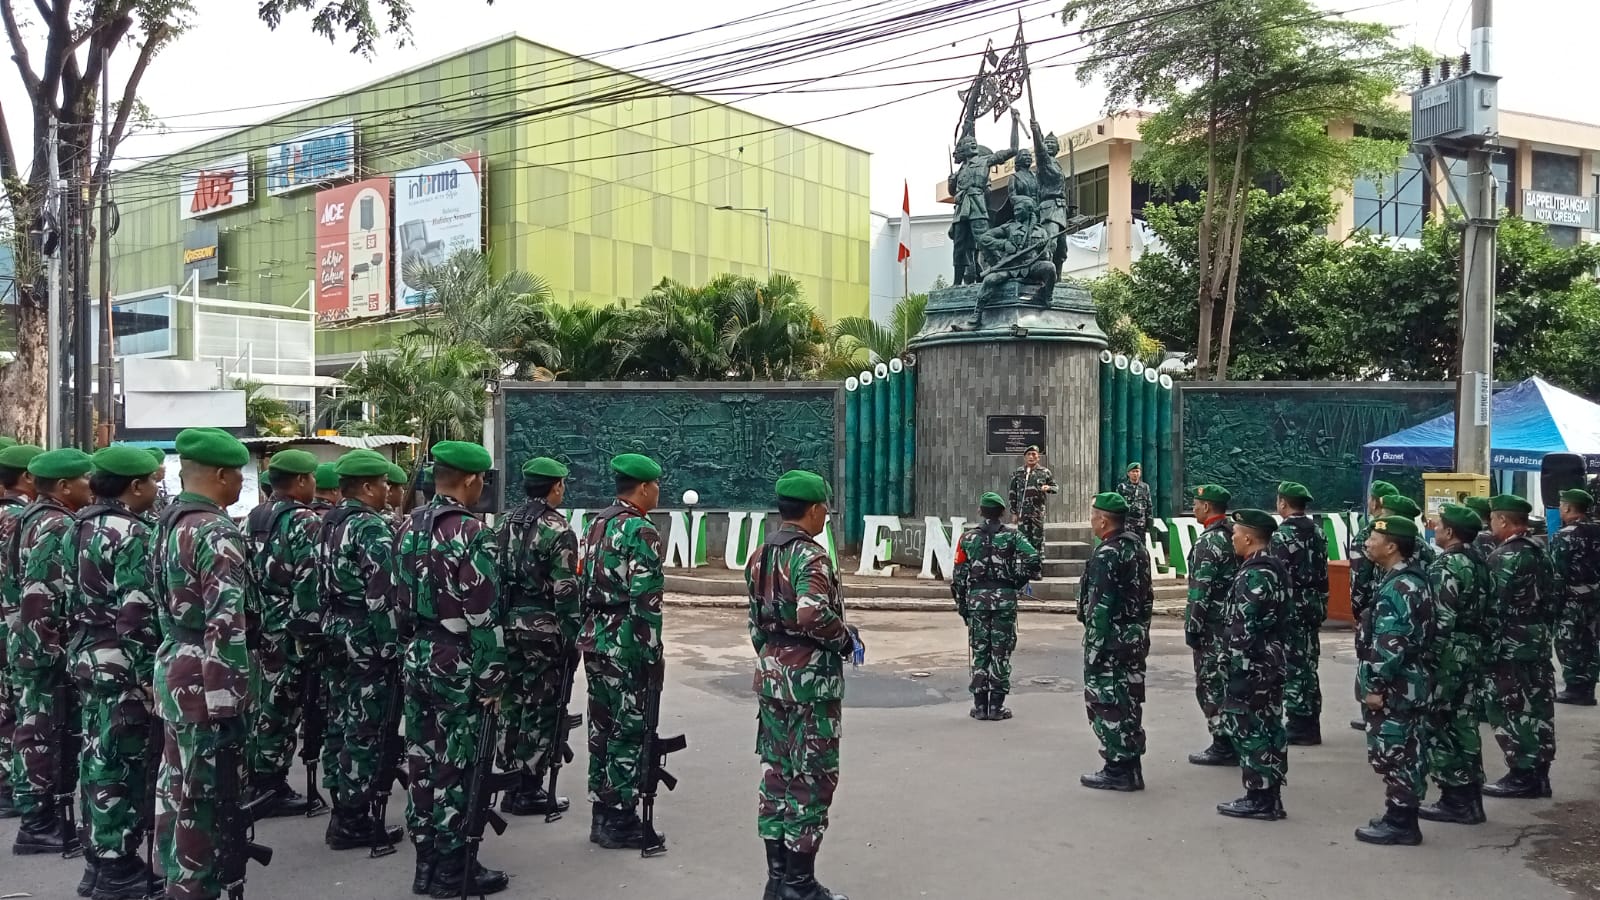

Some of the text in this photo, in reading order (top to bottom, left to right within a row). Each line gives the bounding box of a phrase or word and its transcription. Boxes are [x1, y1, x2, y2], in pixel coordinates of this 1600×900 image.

[190, 169, 234, 213] ACE
[408, 168, 458, 200] informa
[320, 202, 345, 224] ACE
[1535, 209, 1581, 224] KOTA CIREBON
[321, 250, 344, 267] akhir
[321, 267, 345, 284] tahun
[1382, 452, 1404, 460] Biznet
